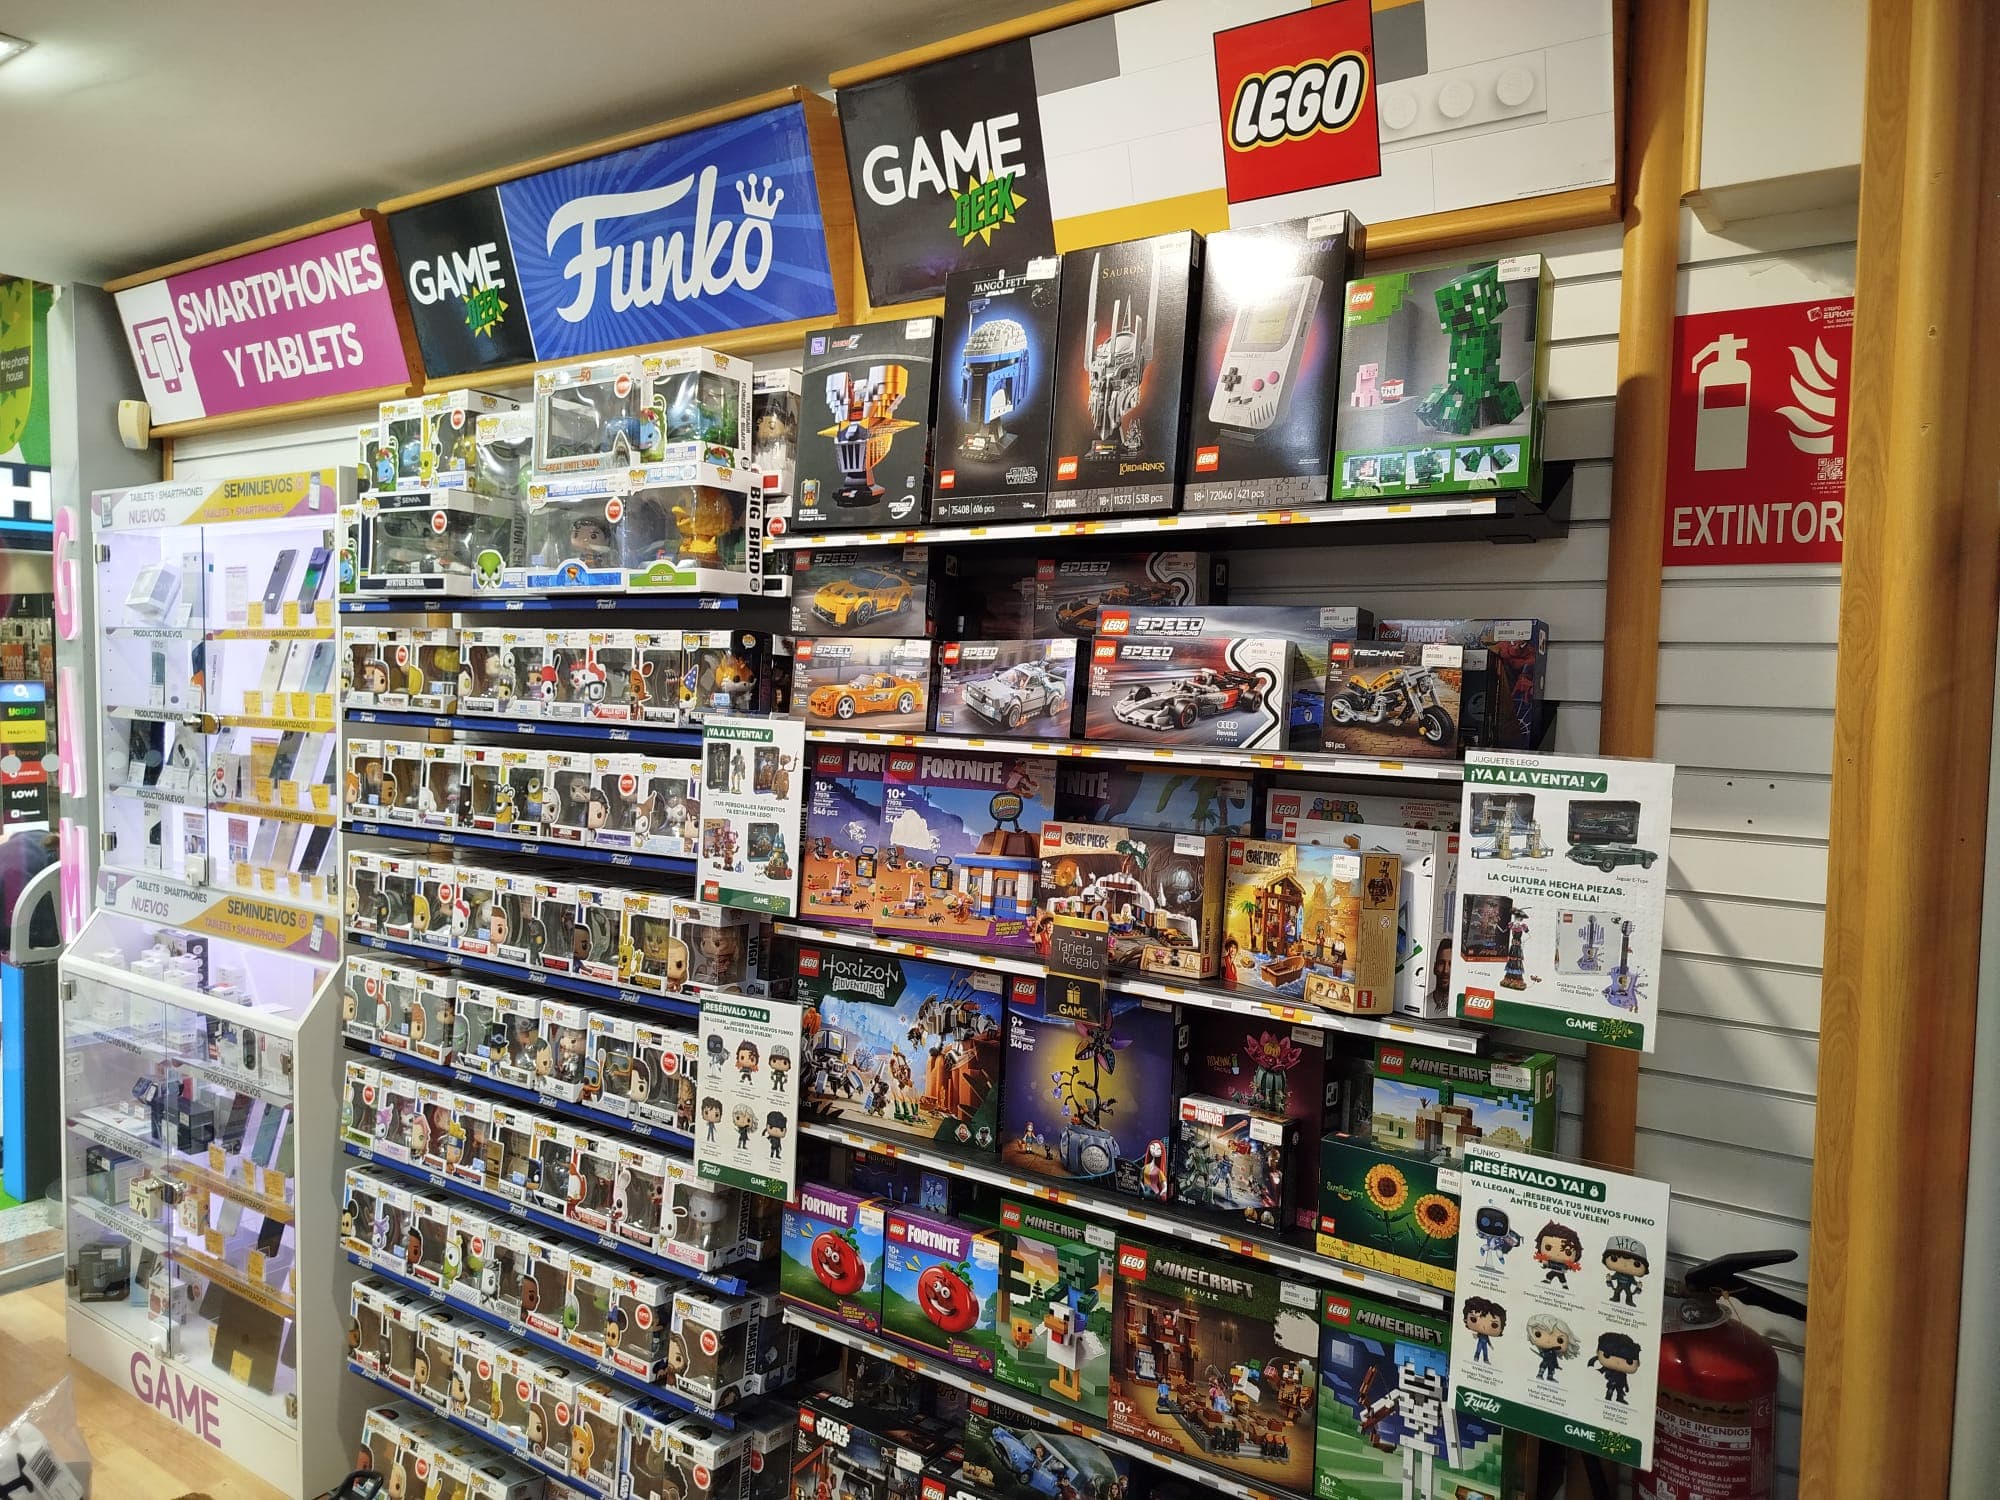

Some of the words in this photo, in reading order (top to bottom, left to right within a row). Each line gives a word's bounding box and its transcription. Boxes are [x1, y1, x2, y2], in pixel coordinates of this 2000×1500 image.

[1232, 53, 1365, 146] LEGO
[863, 113, 1026, 206] GAME
[955, 172, 1017, 238] GEEK
[546, 165, 773, 323] Funko
[409, 242, 505, 305] GAME
[1103, 263, 1144, 279] SAURON
[178, 243, 384, 335] SMARTPHONES
[974, 280, 1004, 294] JANGO
[1351, 291, 1373, 304] LEGO
[467, 286, 503, 330] GEEK
[223, 348, 245, 388] Y
[247, 322, 364, 384] TABLETS
[6, 371, 23, 383] house
[1197, 452, 1218, 466] LEGO
[130, 492, 154, 502] TABLETS
[159, 487, 203, 499] SMARTPHONES
[224, 478, 293, 499] SEMINUEVOS
[1209, 490, 1233, 501] 72046
[1237, 489, 1250, 500] 421
[750, 486, 762, 527] BIG
[1114, 494, 1132, 505] 11373
[1135, 493, 1149, 504] 538
[129, 508, 165, 524] NUEVOS
[1673, 500, 1843, 547] EXTINTOR
[747, 528, 761, 575] BIRD
[796, 554, 810, 566] LEGO
[814, 552, 858, 564] SPEED
[1038, 564, 1054, 575] LEGO
[1059, 562, 1110, 573] SPEED
[1102, 619, 1128, 632] LEGO
[1136, 617, 1205, 631] SPEED
[133, 629, 162, 638] PRODUCTOS
[162, 629, 182, 638] NUEVOS
[1381, 631, 1399, 639] LEGO
[1408, 627, 1448, 642] MARVEL
[797, 646, 812, 656] LEGO
[816, 646, 853, 655] SPEED
[962, 647, 998, 656] SPEED
[1095, 647, 1115, 657] LEGO
[1120, 646, 1173, 657] SPEED
[1353, 649, 1405, 657] TECHNIC
[1093, 667, 1108, 676] 10+
[134, 709, 163, 719] PRODUCTOS
[164, 711, 184, 721] NUEVOS
[707, 728, 718, 736] ¡YA
[726, 729, 735, 737] LA
[736, 730, 762, 739] VENTA!
[819, 754, 841, 765] LEGO
[1473, 756, 1514, 766] JUGUETES
[891, 761, 914, 771] LEGO
[921, 756, 1004, 784] FORTNITE
[1471, 769, 1494, 781] ¡YA
[1496, 770, 1507, 781] A
[1510, 771, 1527, 783] LA
[1530, 772, 1584, 787] VENTA!
[814, 781, 833, 791] 10+
[136, 790, 165, 802] PRODUCTOS
[165, 794, 185, 804] NUEVOS
[887, 789, 906, 799] 10+
[758, 805, 785, 813] FAVORITOS
[813, 807, 826, 815] 546
[1275, 805, 1297, 816] LEGO
[1313, 798, 1357, 813] SUPER
[1044, 831, 1061, 841] LEGO
[611, 853, 632, 865] Funko
[1231, 848, 1243, 857] LEGO
[136, 880, 160, 893] TABLETS
[164, 885, 207, 903] SMARTPHONES
[1487, 873, 1499, 881] LA
[1501, 874, 1546, 887] CULTURA
[1550, 880, 1584, 890] HECHA
[1586, 885, 1626, 896] PIEZAS.
[753, 897, 768, 905] GAME
[1509, 886, 1544, 896] ¡HAZTE
[1547, 890, 1570, 899] CON
[1573, 893, 1600, 903] ELLA!
[131, 896, 169, 916] NUEVOS
[227, 901, 296, 927] SEMINUEVOS
[204, 917, 231, 931] TABLETS
[236, 922, 286, 944] SMARTPHONES
[1057, 939, 1093, 956] Tarjeta
[1062, 951, 1099, 970] Regalo
[800, 958, 817, 968] LEGO
[823, 954, 899, 988] HORIZON
[832, 976, 885, 999] ADVENTURES
[1015, 982, 1035, 994] LEGO
[620, 991, 640, 1003] Funko
[1467, 996, 1491, 1009] LEGO
[703, 1002, 747, 1016] ¡RESÉRVALO
[748, 1009, 760, 1018] YA!
[1059, 1004, 1088, 1019] GAME
[1011, 1016, 1023, 1027] 9+
[1566, 1018, 1598, 1032] GAME
[1382, 1055, 1402, 1066] LEGO
[1410, 1058, 1491, 1082] MINECRAF
[203, 1071, 235, 1093] PRODUCTOS
[236, 1082, 262, 1098] NUEVOS
[1199, 1110, 1224, 1126] MARVEL
[1472, 1147, 1501, 1158] FUNKO
[751, 1177, 767, 1187] GAME
[1469, 1159, 1556, 1188] ¡RESÉRVALO
[1560, 1179, 1585, 1194] YA!
[801, 1193, 848, 1223] FORTNITE
[1471, 1179, 1482, 1187] YA
[1522, 1191, 1563, 1206] ¡RESERVA
[1565, 1200, 1582, 1210] TUS
[1584, 1204, 1621, 1218] NUEVOS
[1623, 1213, 1655, 1226] FUNKO
[784, 1213, 795, 1223] 10+
[1002, 1208, 1020, 1222] LEGO
[1510, 1197, 1537, 1210] ANTES
[1540, 1203, 1551, 1212] DE
[1553, 1206, 1571, 1217] QUE
[1574, 1210, 1610, 1225] VUELEN!
[889, 1224, 905, 1235] LEGO
[907, 1224, 960, 1256] FORTNITE
[888, 1245, 899, 1255] 10+
[1121, 1254, 1146, 1270] LEGO
[1154, 1259, 1254, 1299] MINECRAFT
[1184, 1286, 1219, 1301] MOVIE
[1328, 1303, 1349, 1317] LEGO
[1356, 1309, 1443, 1346] MINECRAFT
[746, 1323, 759, 1376] MACREADY
[130, 1351, 221, 1449] GAME
[971, 1397, 988, 1409] LEGO
[1112, 1400, 1133, 1414] 10+
[1464, 1391, 1502, 1413] Funko
[819, 1417, 850, 1437] STAR
[1147, 1428, 1160, 1440] 491
[1564, 1424, 1597, 1443] GAME
[1694, 1424, 1750, 1436] INCENDIOS
[1320, 1475, 1337, 1487] 10+
